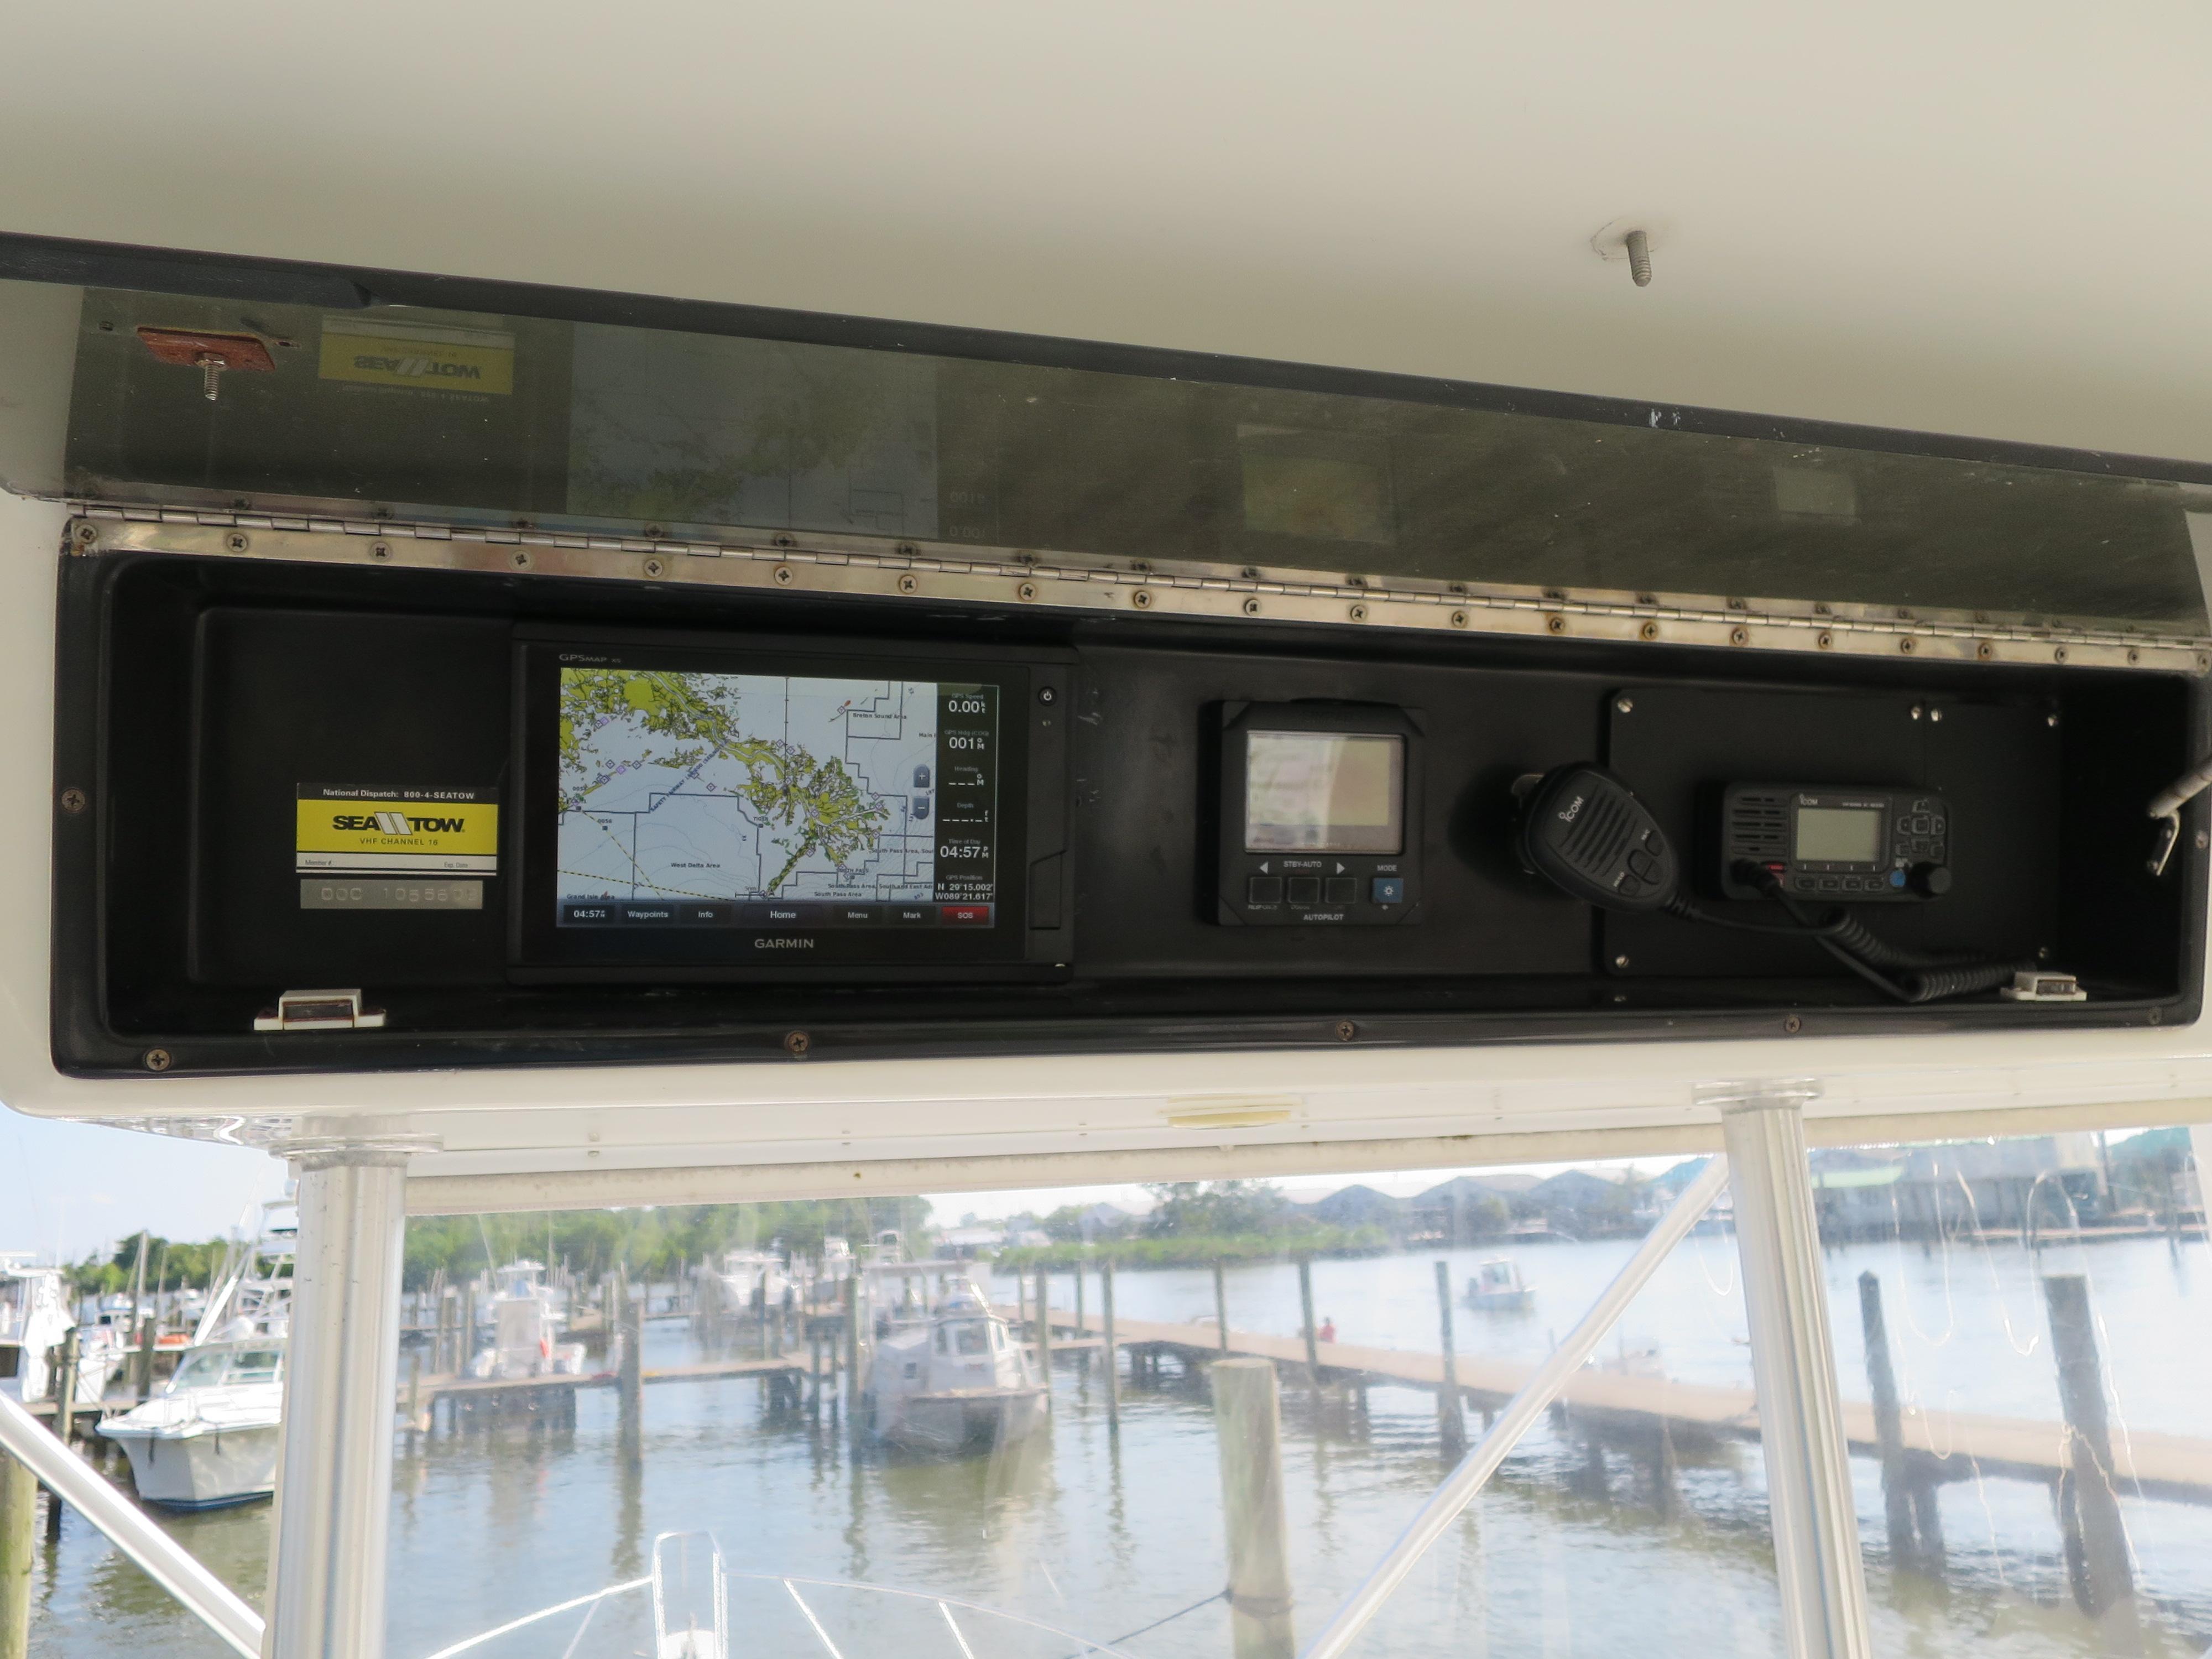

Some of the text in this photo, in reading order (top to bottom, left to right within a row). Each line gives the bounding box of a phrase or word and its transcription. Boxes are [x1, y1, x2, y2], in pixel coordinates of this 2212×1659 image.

[948, 700, 979, 713] 0.00
[949, 737, 974, 749] 001
[323, 789, 475, 800] National Dispatch: 800-4-SEATOW
[333, 815, 463, 833] SEA TOW
[940, 846, 980, 858] 04:57
[573, 910, 599, 918] 04:57
[628, 911, 669, 920] Waypoints
[754, 939, 814, 949] GARMIN
